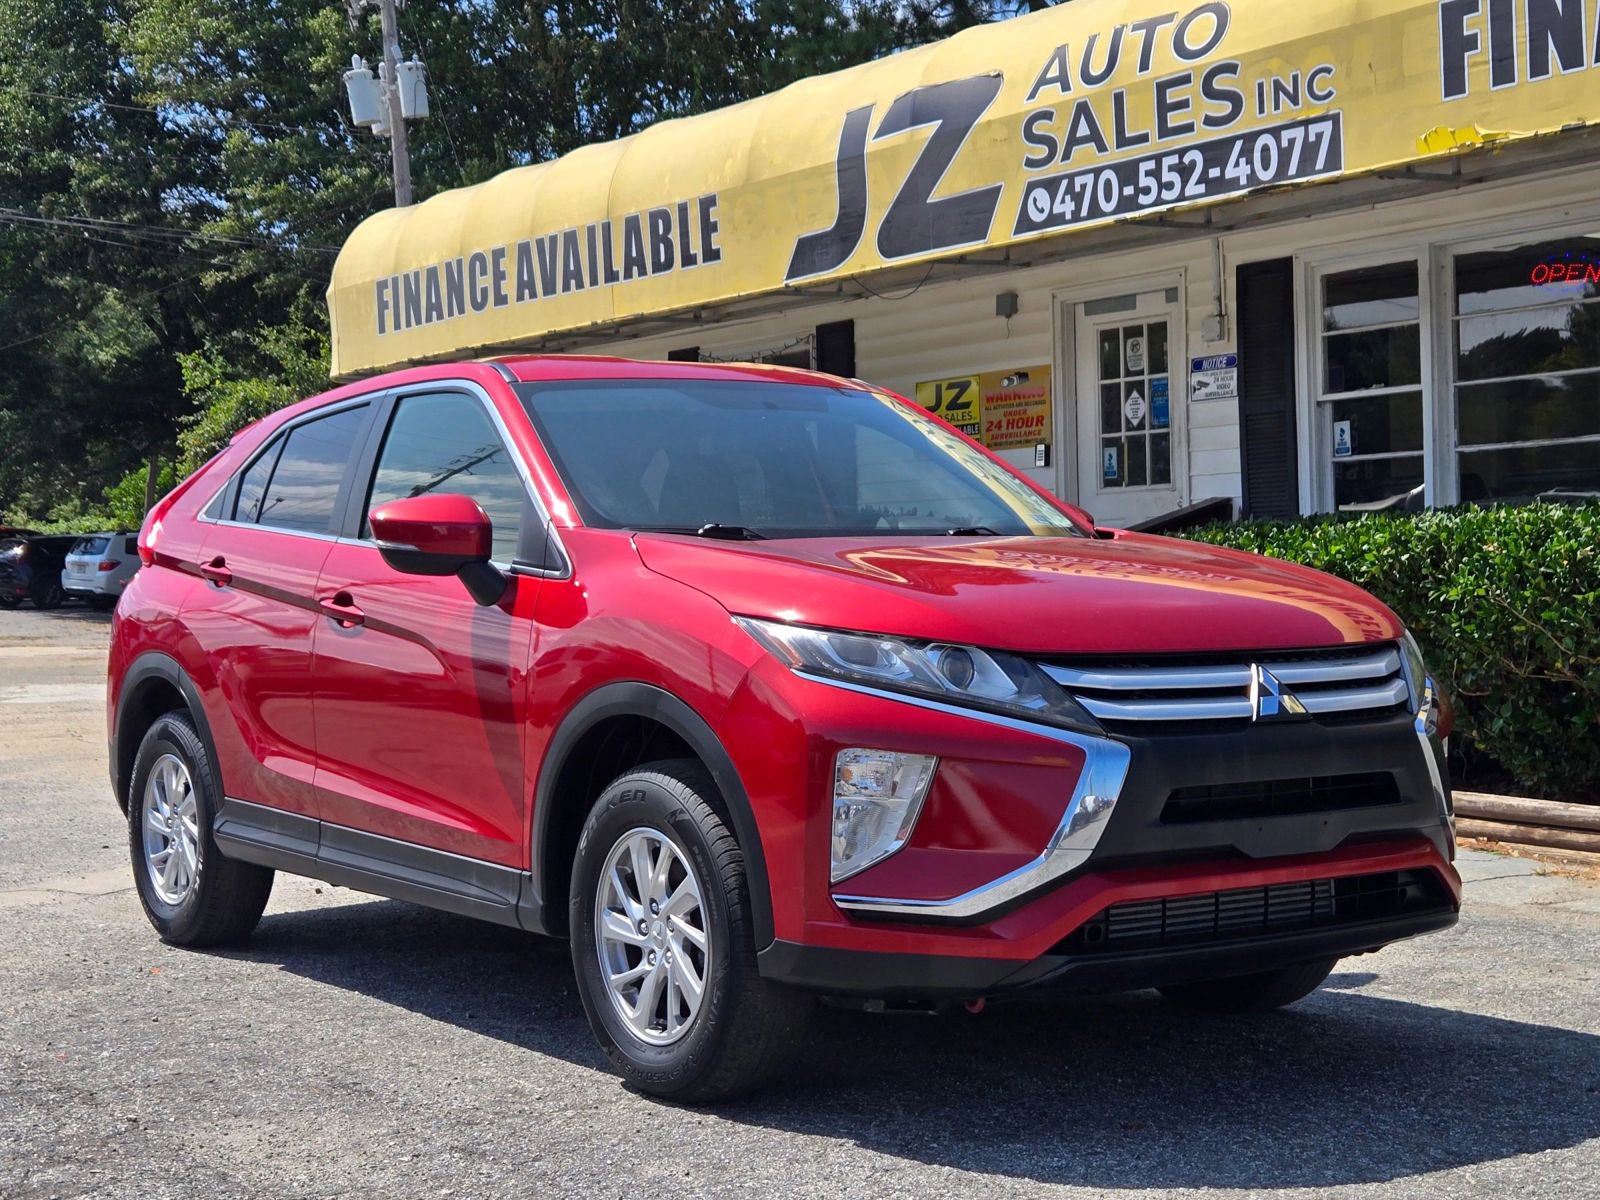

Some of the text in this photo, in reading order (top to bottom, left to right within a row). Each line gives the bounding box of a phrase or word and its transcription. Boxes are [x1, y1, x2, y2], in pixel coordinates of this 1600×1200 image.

[1026, 1, 1231, 102] AUTO
[1023, 61, 1336, 170] SALES INC
[784, 70, 1005, 286] JZ
[1052, 120, 1334, 220] 470-552-4077
[376, 192, 722, 335] FINANCE AVAILABLE
[1531, 263, 1600, 284] OPEN
[1202, 357, 1227, 370] NOTICE
[924, 380, 972, 413] JZ
[944, 410, 972, 423] SALES
[985, 415, 1045, 432] 24 HOUR
[1003, 408, 1028, 417] UNDER
[991, 430, 1042, 441] SURVEILLANCE
